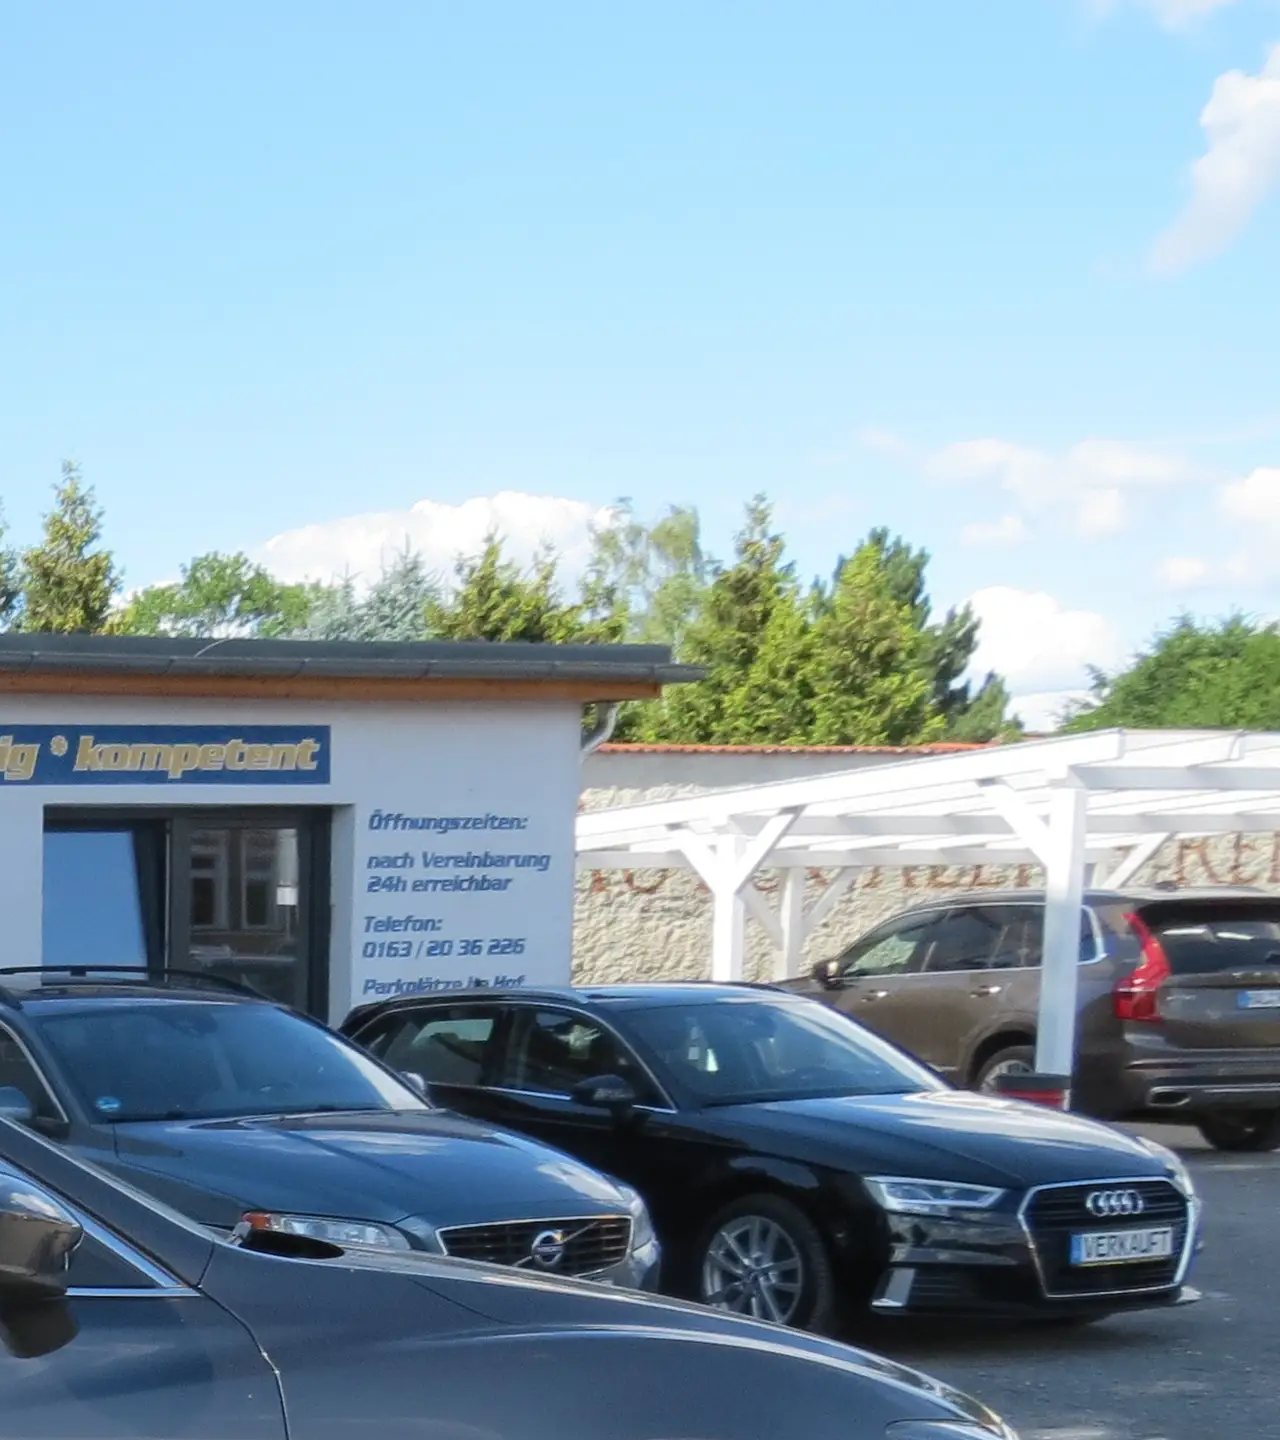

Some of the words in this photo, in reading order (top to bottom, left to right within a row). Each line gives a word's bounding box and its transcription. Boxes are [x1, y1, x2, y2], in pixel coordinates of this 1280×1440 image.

[73, 735, 320, 779] kompetent
[367, 852, 414, 869] nach
[422, 851, 551, 871] Vereinbarung
[367, 875, 407, 892] 24h
[412, 874, 512, 892] erreichbar
[364, 915, 444, 933] Telefon:
[426, 939, 453, 956] 20
[1083, 1229, 1171, 1259] VERKAUFT
